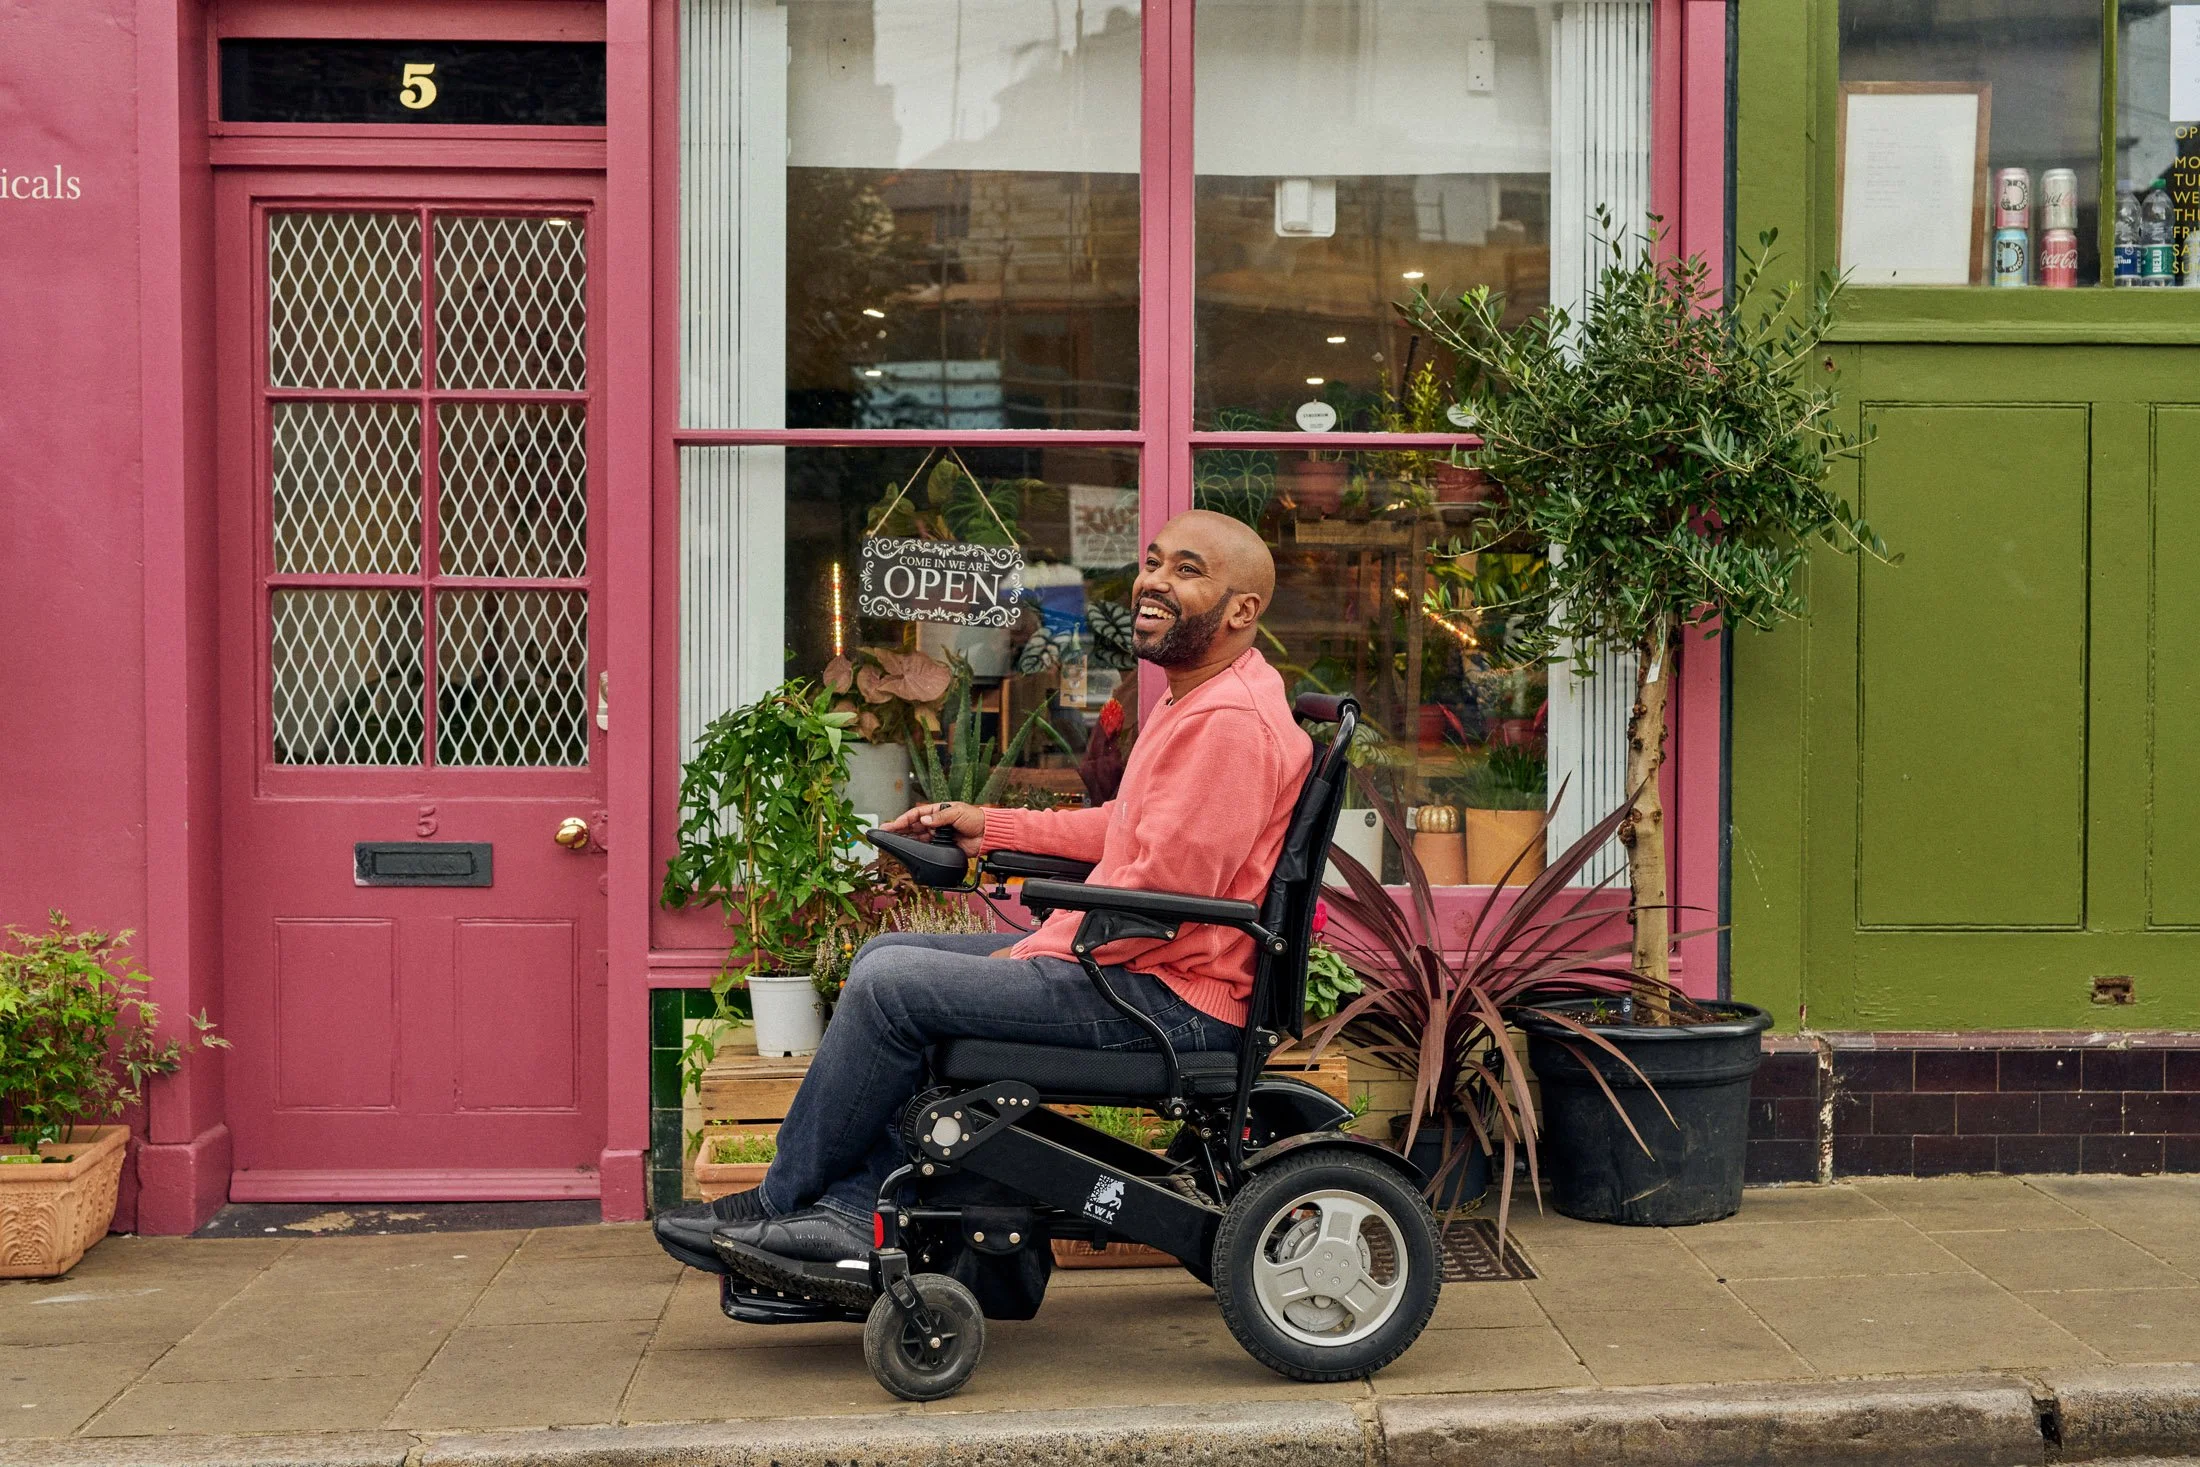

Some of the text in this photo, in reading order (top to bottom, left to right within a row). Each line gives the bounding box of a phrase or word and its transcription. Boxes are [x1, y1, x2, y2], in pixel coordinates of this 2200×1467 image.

[399, 63, 437, 109] 5
[2175, 126, 2198, 139] OP
[0, 164, 81, 200] icals
[2173, 173, 2200, 187] TU
[899, 555, 991, 573] COME IN WE ARE
[883, 565, 1003, 606] OPEN
